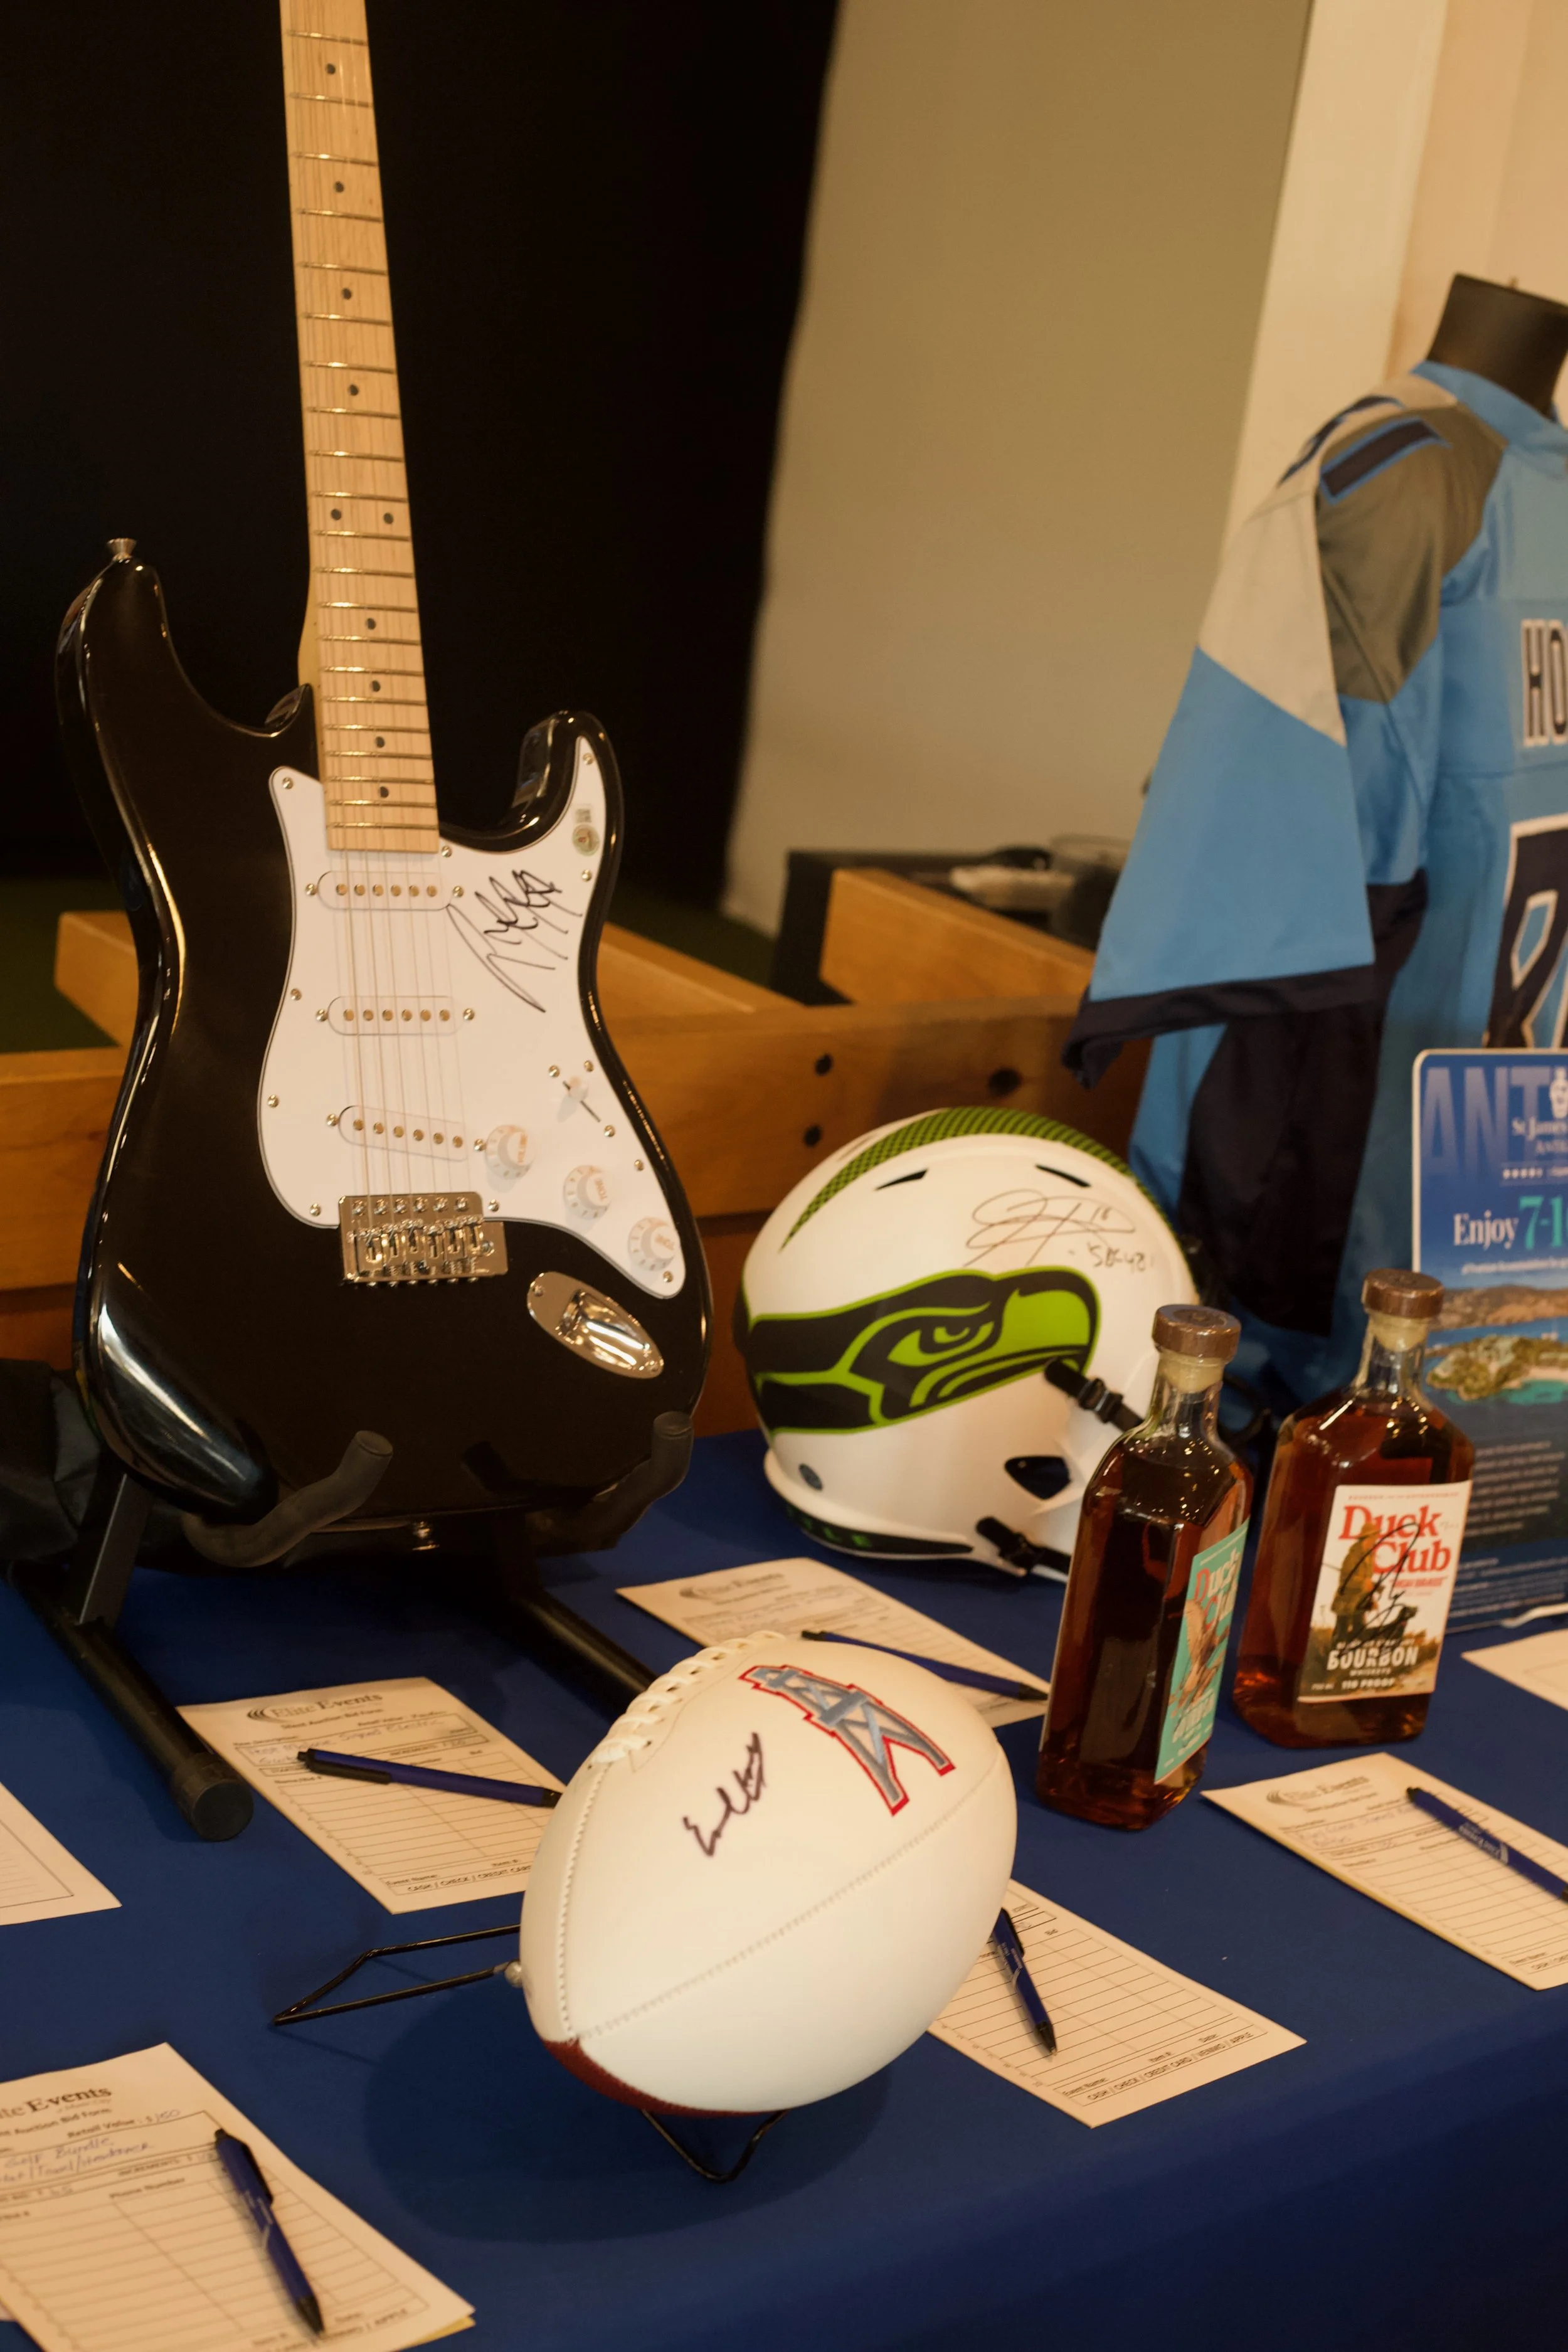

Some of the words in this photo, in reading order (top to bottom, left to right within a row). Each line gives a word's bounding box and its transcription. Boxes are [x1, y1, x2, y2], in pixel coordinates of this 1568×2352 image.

[1453, 1210, 1520, 1251] Enjoy
[1518, 1194, 1568, 1250] 7-1
[1337, 1504, 1443, 1540] Duck
[1373, 1539, 1451, 1574] Club
[1326, 1646, 1419, 1671] BOURBON
[271, 1703, 317, 1719] Elite
[316, 1693, 383, 1710] Events
[1087, 2090, 1108, 2100] CASH
[1113, 2077, 1140, 2090] CHECK
[1143, 2065, 1172, 2078] CREDIT
[1170, 2056, 1193, 2067] CARD
[1197, 2043, 1226, 2057] VENMO
[1229, 2032, 1254, 2043] APPLE
[26, 2087, 112, 2112] Events
[14, 2121, 60, 2135] Auction
[60, 2113, 80, 2124] Bid
